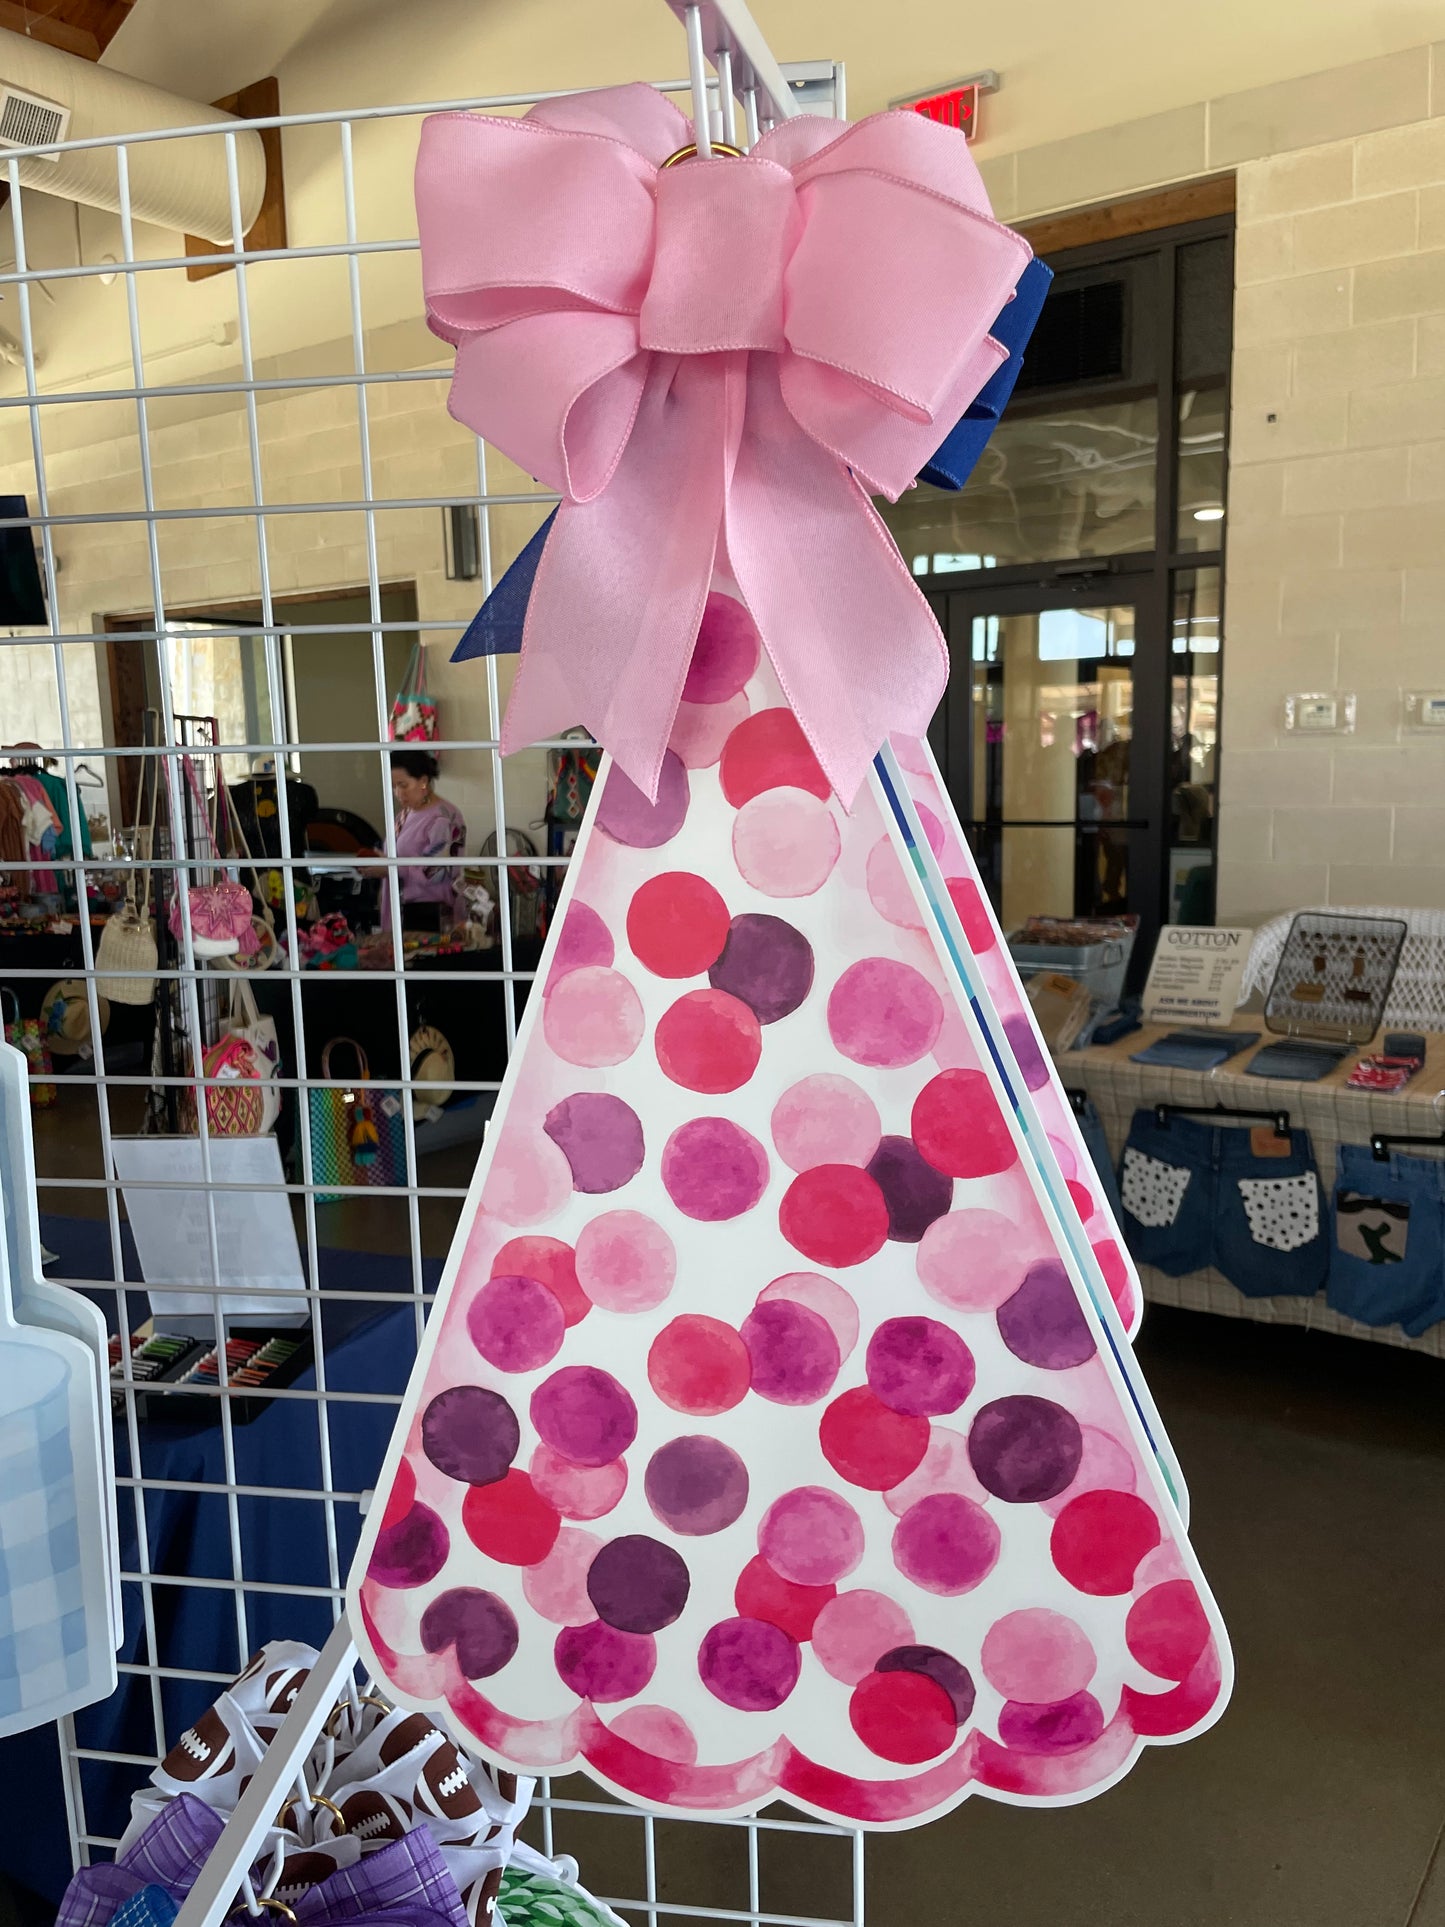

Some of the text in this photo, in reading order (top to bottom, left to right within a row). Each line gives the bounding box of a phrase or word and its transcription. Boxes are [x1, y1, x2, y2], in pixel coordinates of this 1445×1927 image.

[915, 91, 964, 128] XIT
[1168, 930, 1242, 946] COTTON
[1192, 998, 1218, 1006] ABOUT
